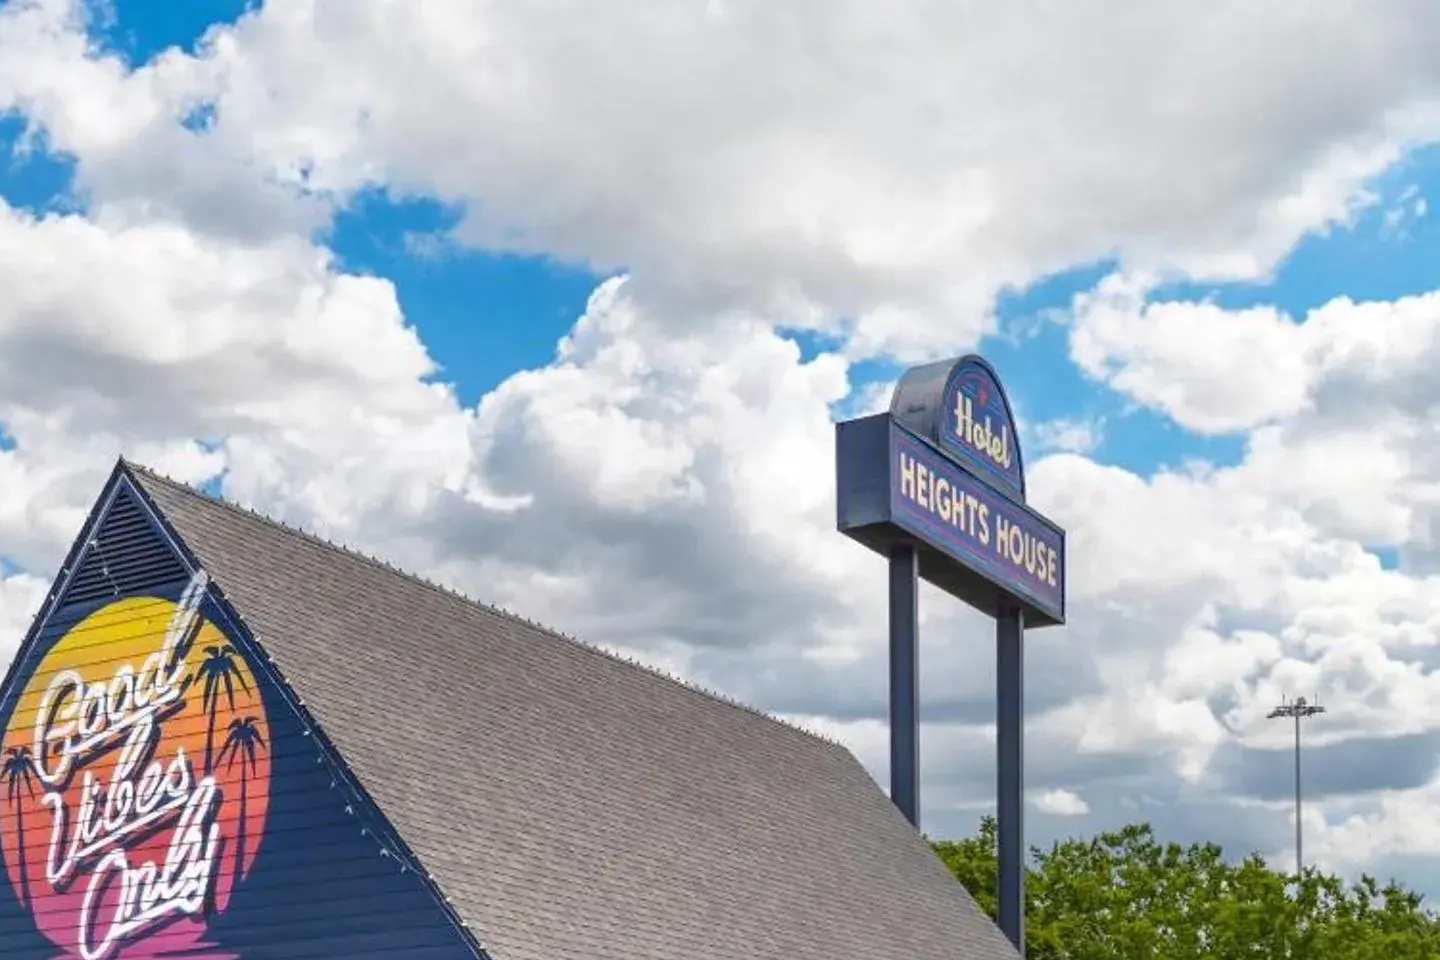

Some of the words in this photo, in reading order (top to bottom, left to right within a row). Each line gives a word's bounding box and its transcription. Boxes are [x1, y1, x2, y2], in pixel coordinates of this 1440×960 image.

[954, 392, 1010, 468] Hotel
[900, 453, 990, 545] HEIGHTS
[996, 515, 1057, 587] HOUSE
[34, 570, 207, 783] Good
[42, 712, 193, 883] Vibes
